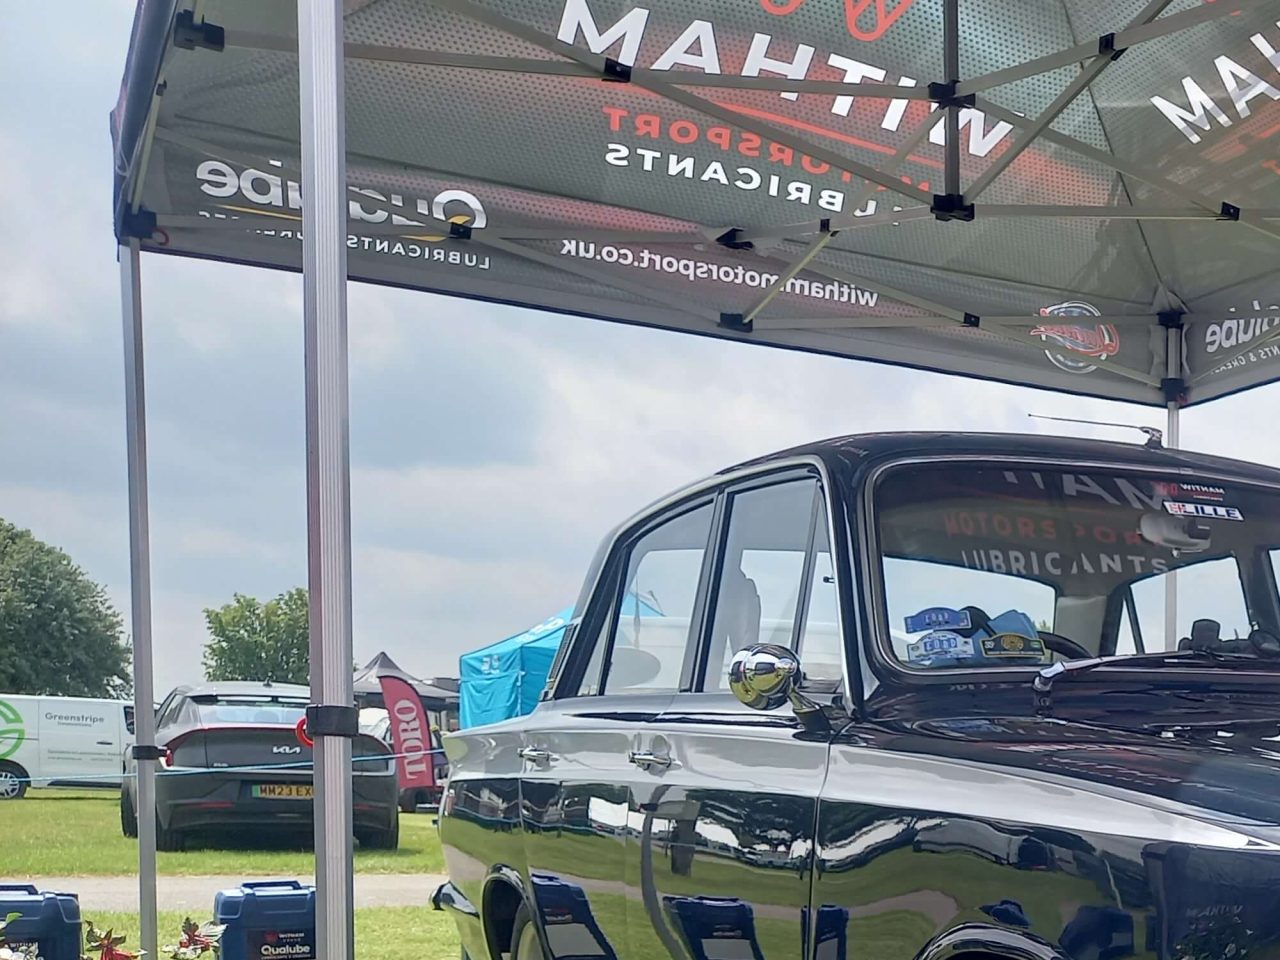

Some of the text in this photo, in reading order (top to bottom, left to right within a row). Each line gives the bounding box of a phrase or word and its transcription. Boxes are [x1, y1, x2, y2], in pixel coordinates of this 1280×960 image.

[44, 711, 105, 723] Greenstripe
[394, 699, 427, 780] TORO
[296, 786, 313, 798] EX
[261, 944, 310, 956] Qualube
